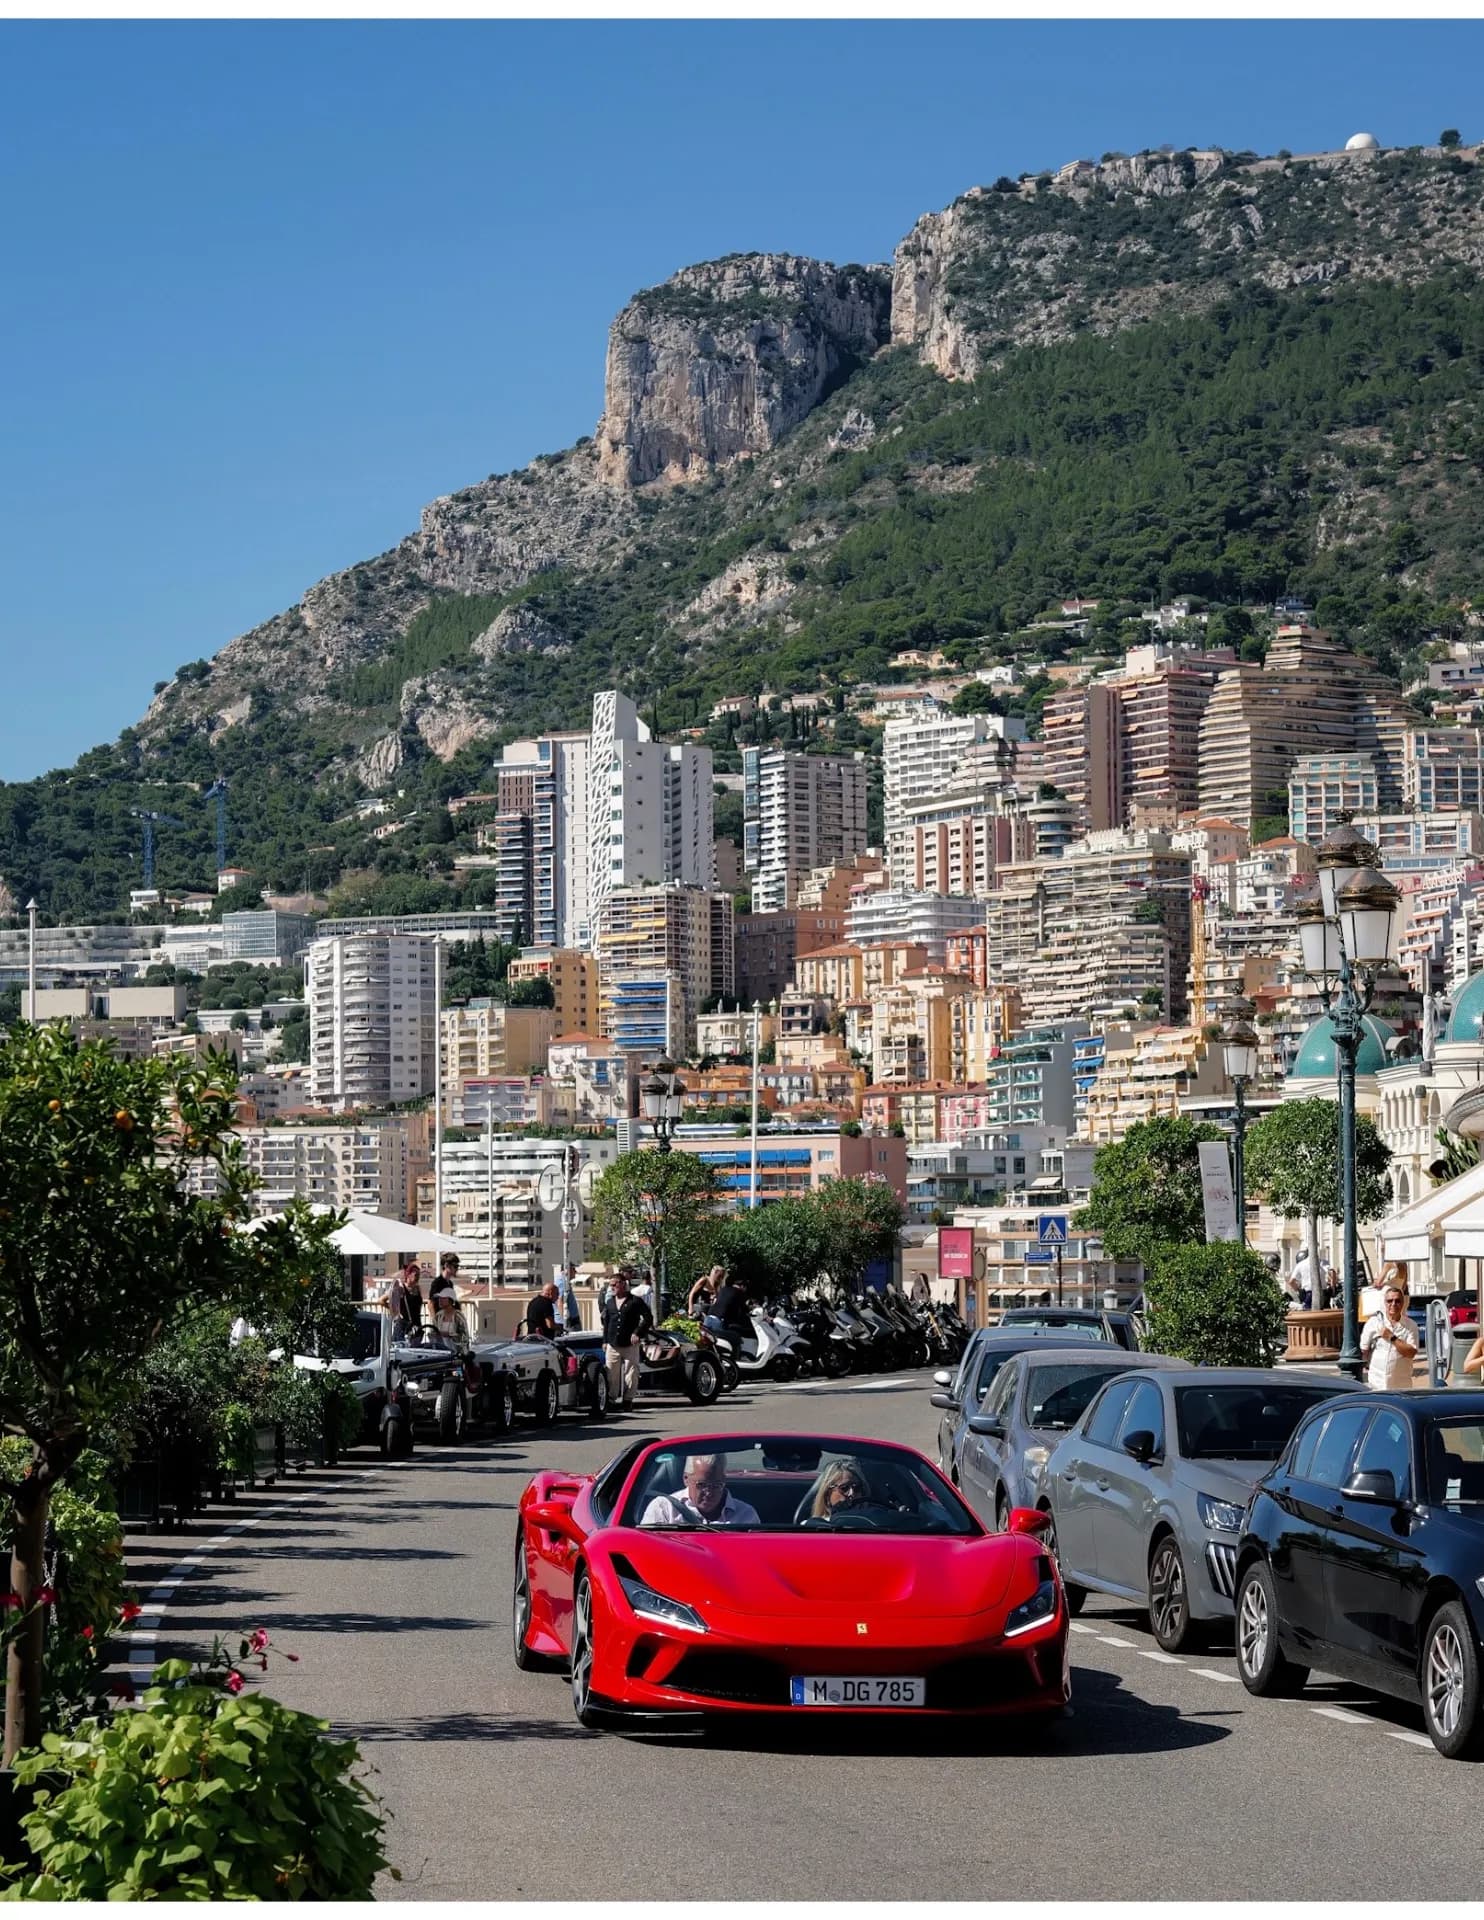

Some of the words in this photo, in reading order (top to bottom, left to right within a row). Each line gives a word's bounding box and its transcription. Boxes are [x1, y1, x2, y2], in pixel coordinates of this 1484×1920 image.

[813, 1680, 828, 1701] M
[842, 1681, 870, 1702] DG
[875, 1681, 916, 1702] 785
